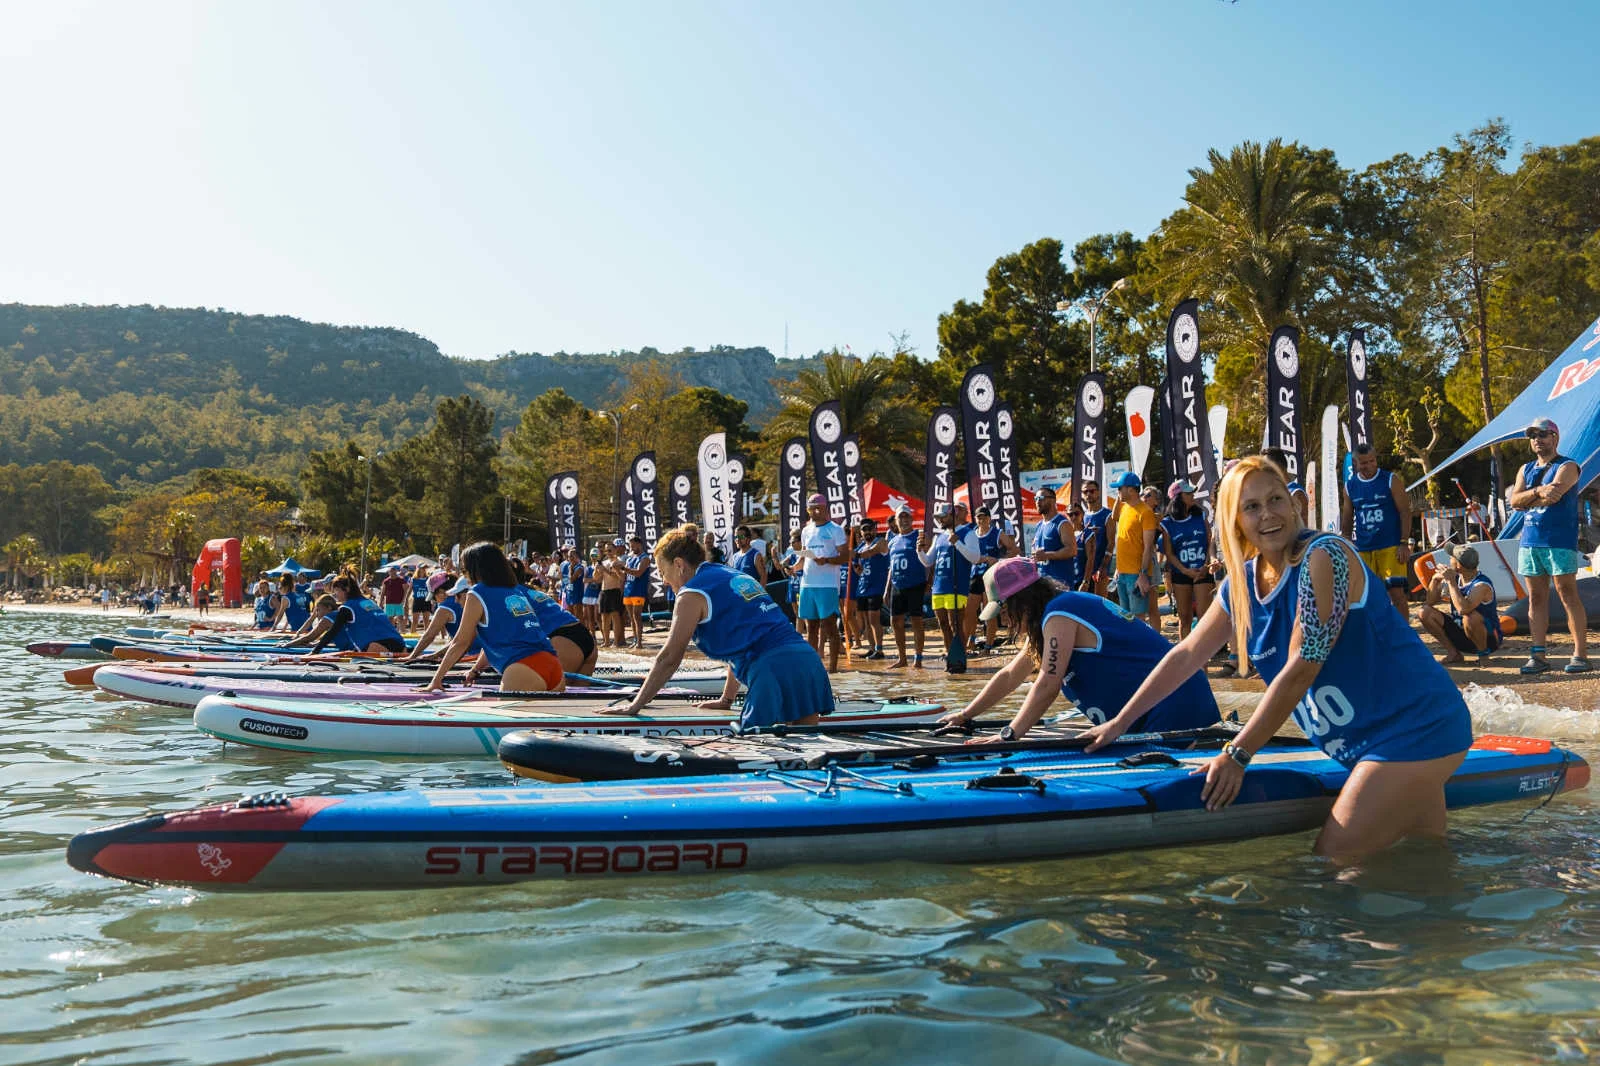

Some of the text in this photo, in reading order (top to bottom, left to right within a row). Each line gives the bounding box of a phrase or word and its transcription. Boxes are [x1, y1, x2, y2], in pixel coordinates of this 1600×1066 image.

[1547, 357, 1600, 401] Re
[1182, 374, 1210, 499] KBEAR
[1279, 386, 1298, 474] BEAR
[823, 450, 847, 519] BEAR
[932, 451, 949, 535] KBEAR
[975, 420, 1001, 522] KBEAR
[563, 503, 576, 547] BEAR
[710, 476, 728, 545] KBEAR
[789, 476, 801, 529] BEAR
[846, 472, 861, 526] BEAR
[1360, 509, 1384, 525] 148
[1180, 547, 1206, 562] 054
[243, 720, 304, 737] FUSIONTECH
